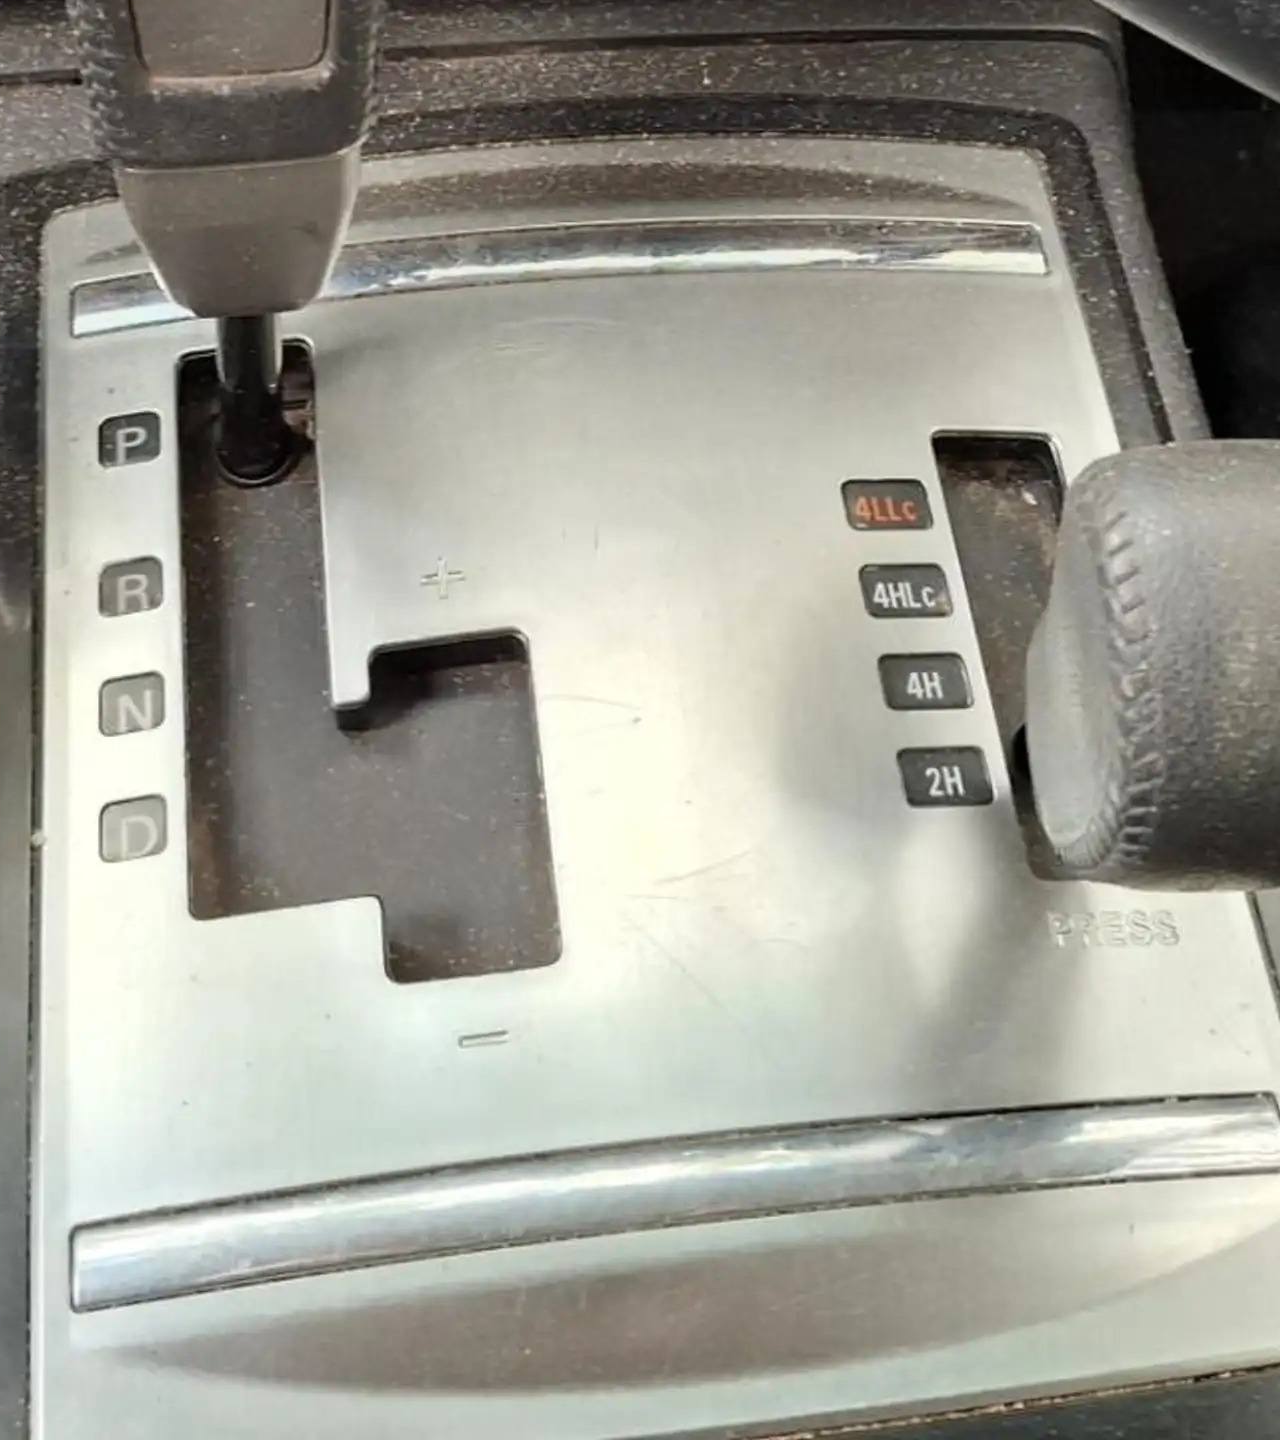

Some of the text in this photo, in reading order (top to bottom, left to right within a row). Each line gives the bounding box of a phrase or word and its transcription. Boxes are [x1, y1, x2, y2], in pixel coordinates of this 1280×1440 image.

[114, 426, 148, 460] P
[116, 573, 151, 613] R
[906, 671, 944, 700] 4H
[119, 688, 154, 731] N
[924, 765, 966, 797] 2H
[121, 813, 158, 860] D
[1047, 909, 1180, 948] PRESS
